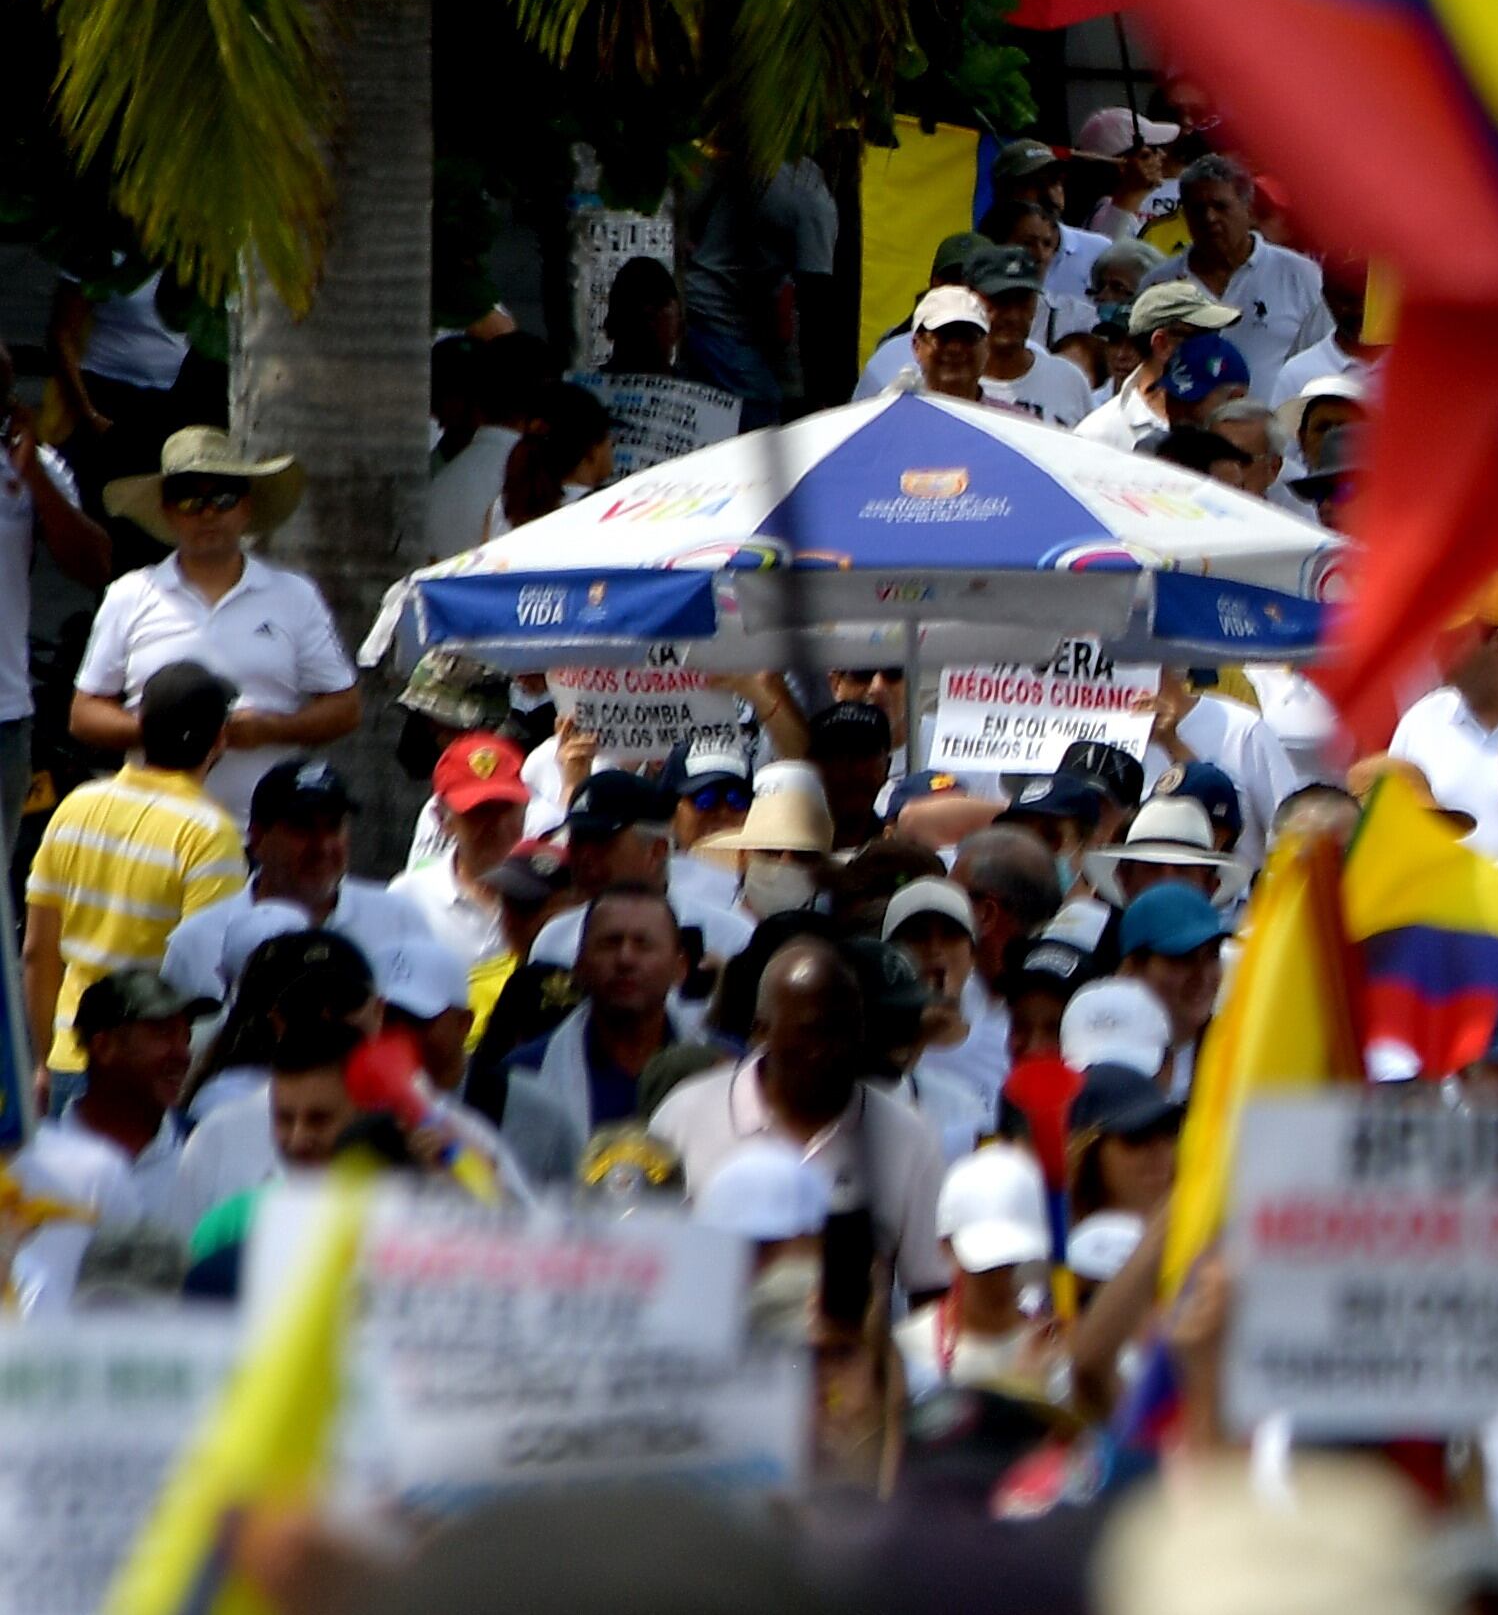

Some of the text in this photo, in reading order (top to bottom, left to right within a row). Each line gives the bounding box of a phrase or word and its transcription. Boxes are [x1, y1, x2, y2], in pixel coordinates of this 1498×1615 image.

[517, 601, 565, 627] VIDA
[625, 667, 709, 694] CUBANO
[948, 666, 1151, 713] MÉDICOS CUBANO
[600, 701, 694, 726] COLOMBIA
[623, 726, 651, 749] LOS
[982, 715, 1108, 740] EN COLOMBIA
[941, 735, 1022, 759] TENEMOS
